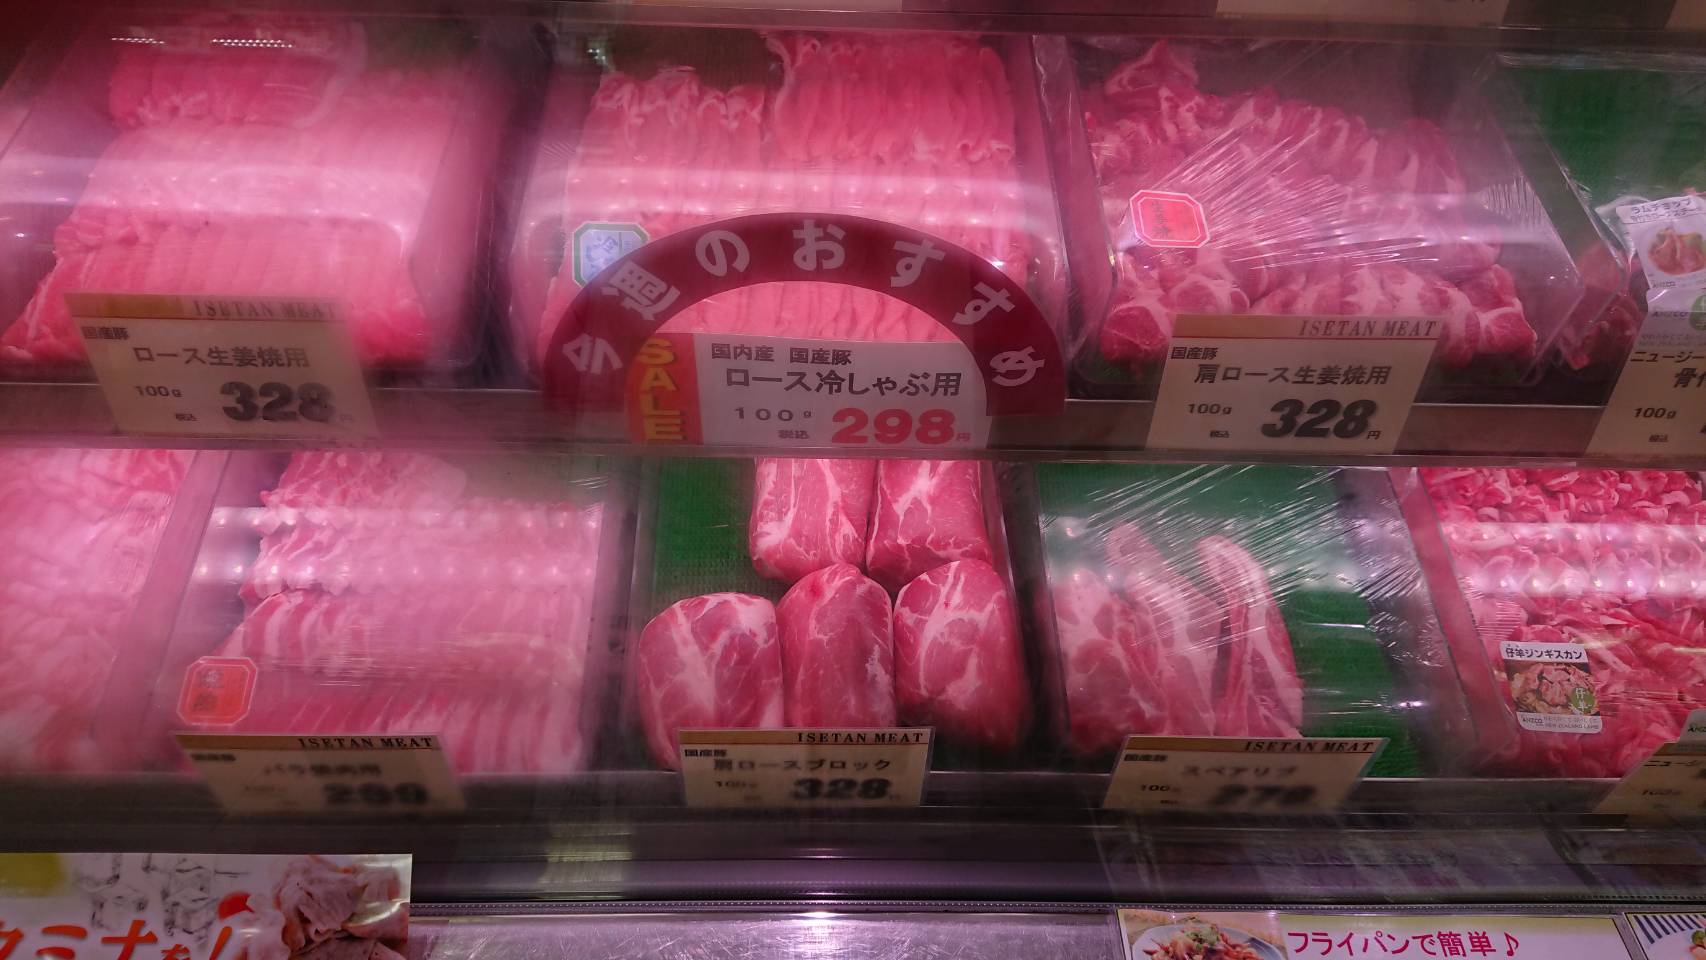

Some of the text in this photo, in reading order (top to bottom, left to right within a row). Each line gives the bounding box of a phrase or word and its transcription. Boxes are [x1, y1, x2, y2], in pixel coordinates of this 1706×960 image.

[192, 301, 338, 320] ISETAN MEAT
[562, 219, 1046, 387] 今週のおすすめ
[82, 326, 130, 341] 国産豚
[1300, 319, 1438, 338] ISETAN MEAT
[133, 346, 310, 369] ロース生姜焼用
[711, 342, 853, 366] 国内産 国産豚
[1170, 346, 1219, 360] 国産豚
[1194, 363, 1393, 386] 肩ロース生姜焼用
[639, 338, 688, 442] SALE
[726, 368, 963, 398] ロース冷しゃぶ用
[134, 384, 184, 399] 100g
[1187, 403, 1233, 416] 100g
[1634, 407, 1678, 420] 100g
[1505, 647, 1583, 660] 仔羊ジンギスカン
[298, 737, 433, 749] ISETAN MEAT
[797, 732, 924, 743] ISETAN MEAT
[1244, 741, 1375, 752] ISETAN MEAT
[713, 758, 892, 772] 肩ロースブロック
